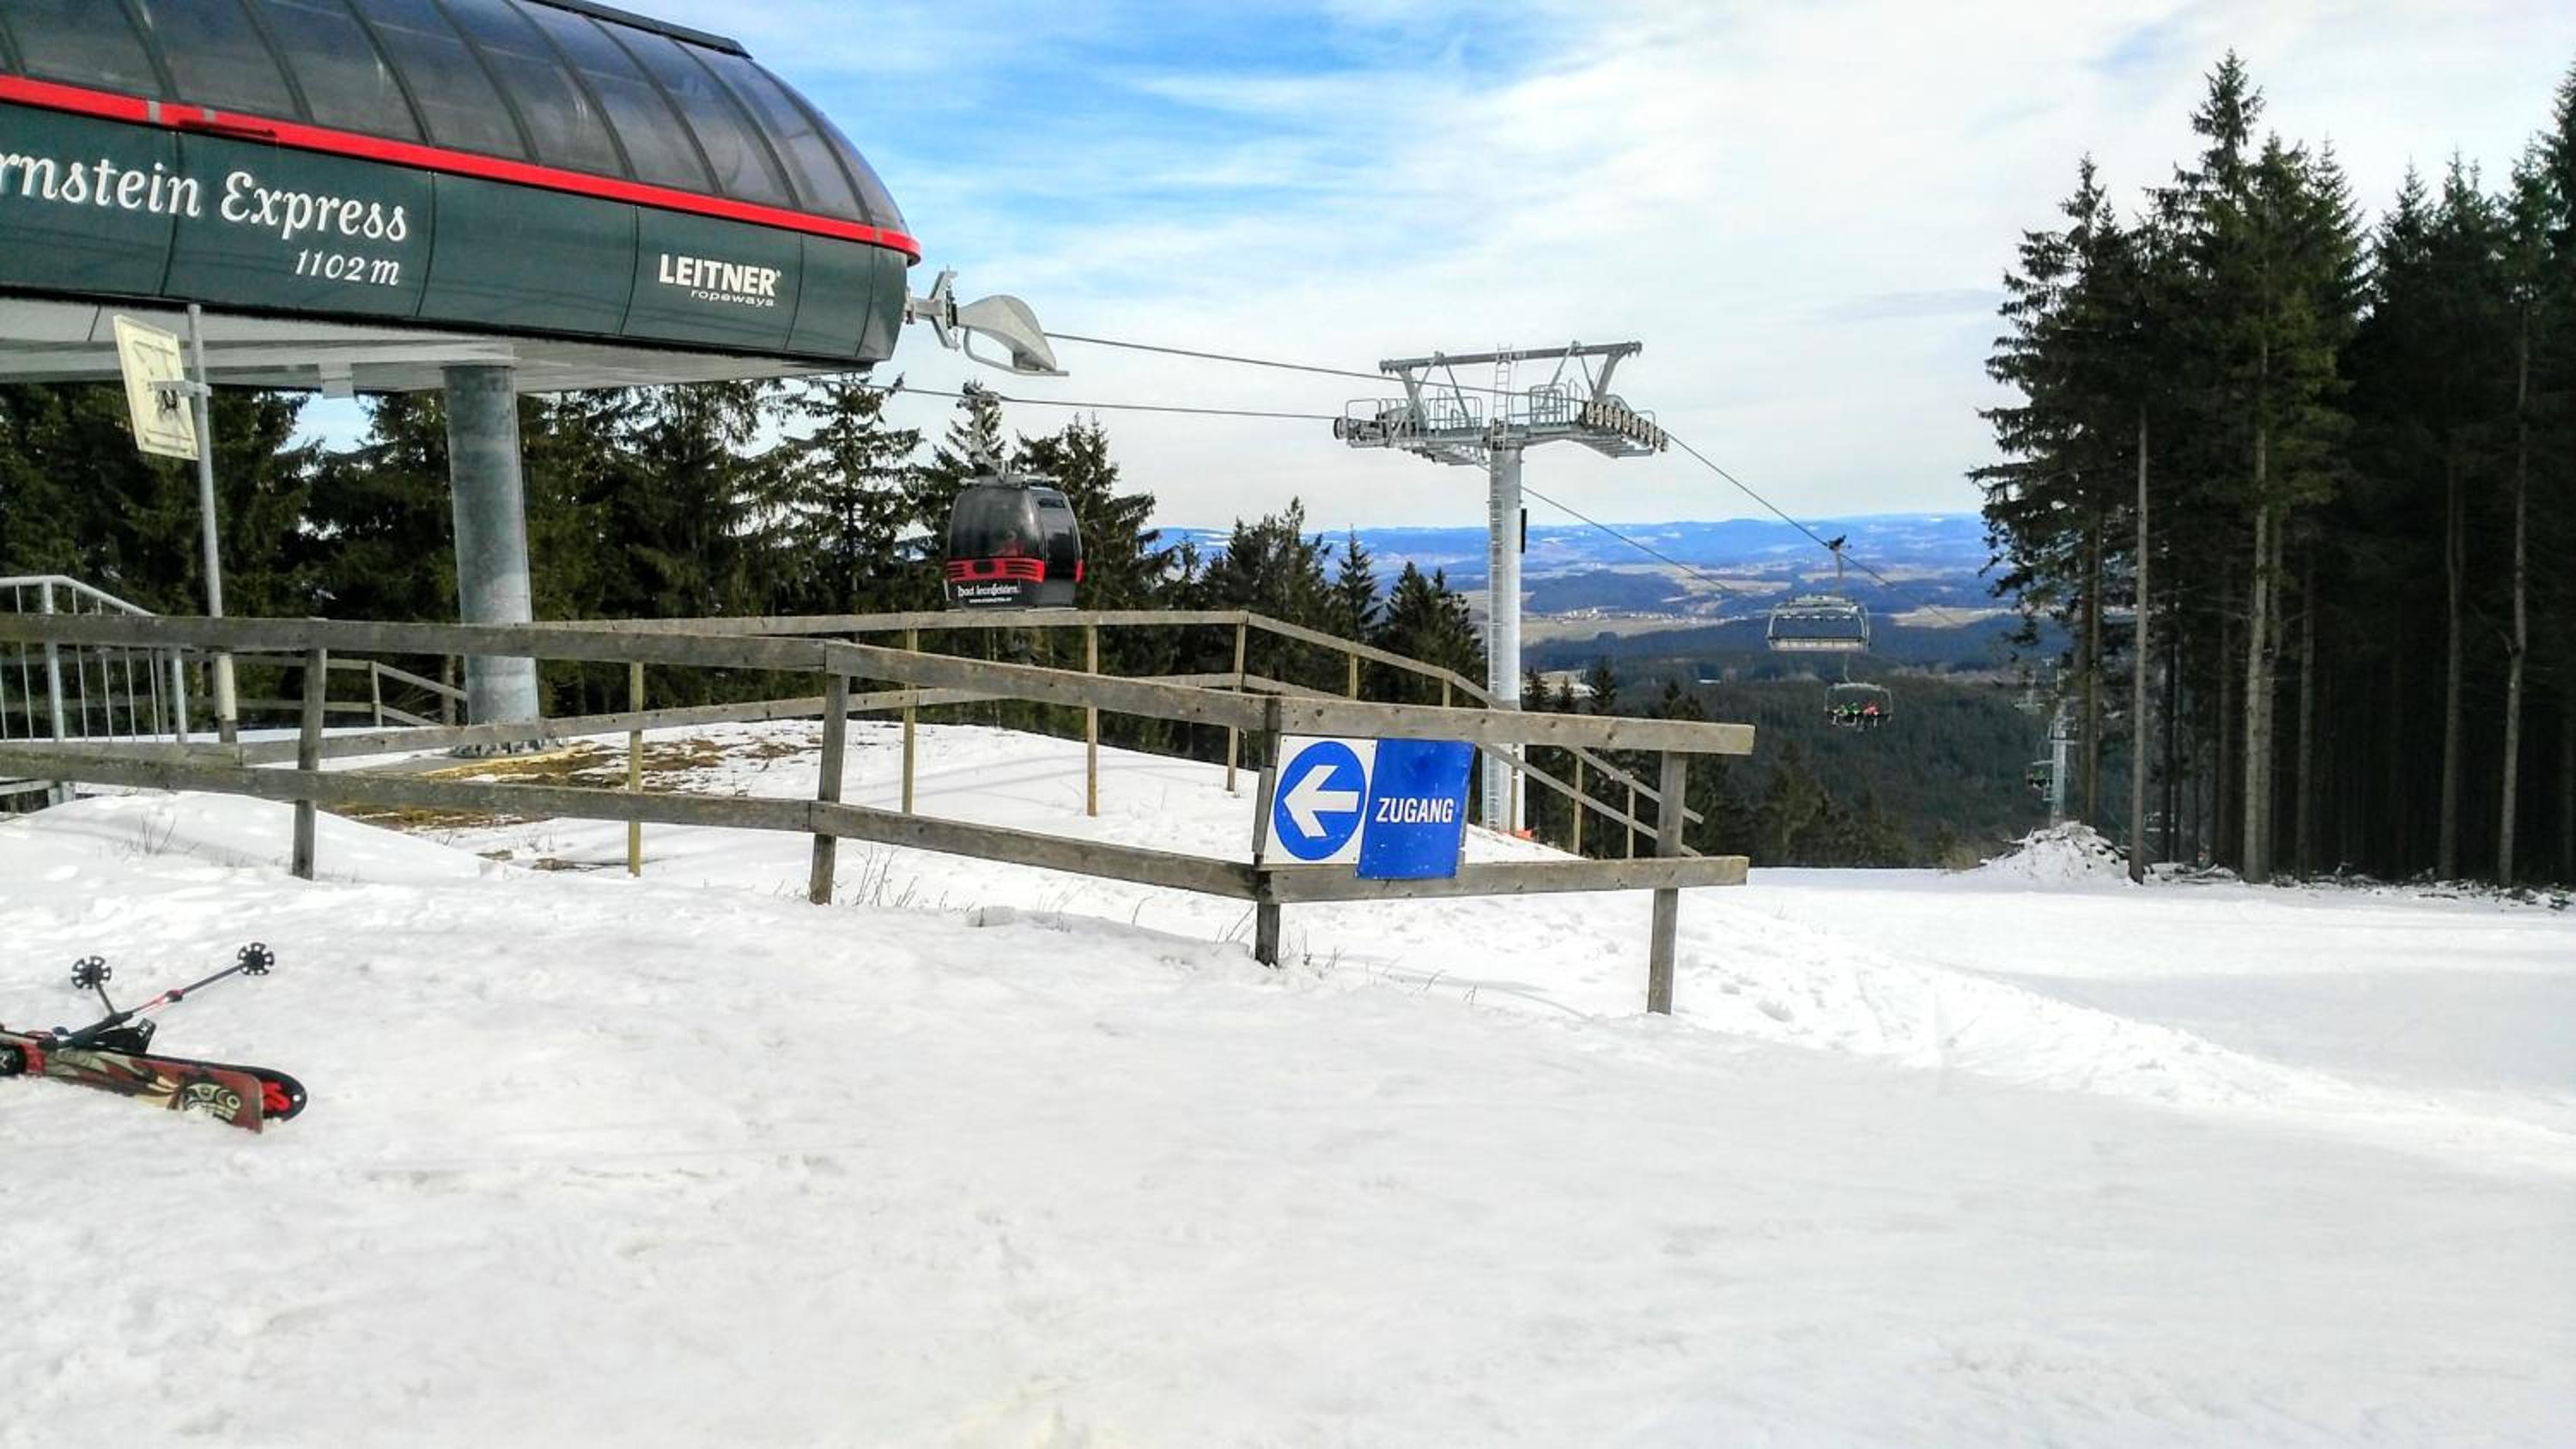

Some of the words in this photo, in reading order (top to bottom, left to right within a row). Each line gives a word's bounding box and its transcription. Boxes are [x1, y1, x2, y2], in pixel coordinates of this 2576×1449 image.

[221, 171, 409, 242] Express
[295, 249, 364, 282] 1102
[370, 260, 399, 286] m
[659, 253, 777, 297] LEITNER
[690, 289, 775, 307] ropeways
[1376, 797, 1455, 823] ZUGANG
